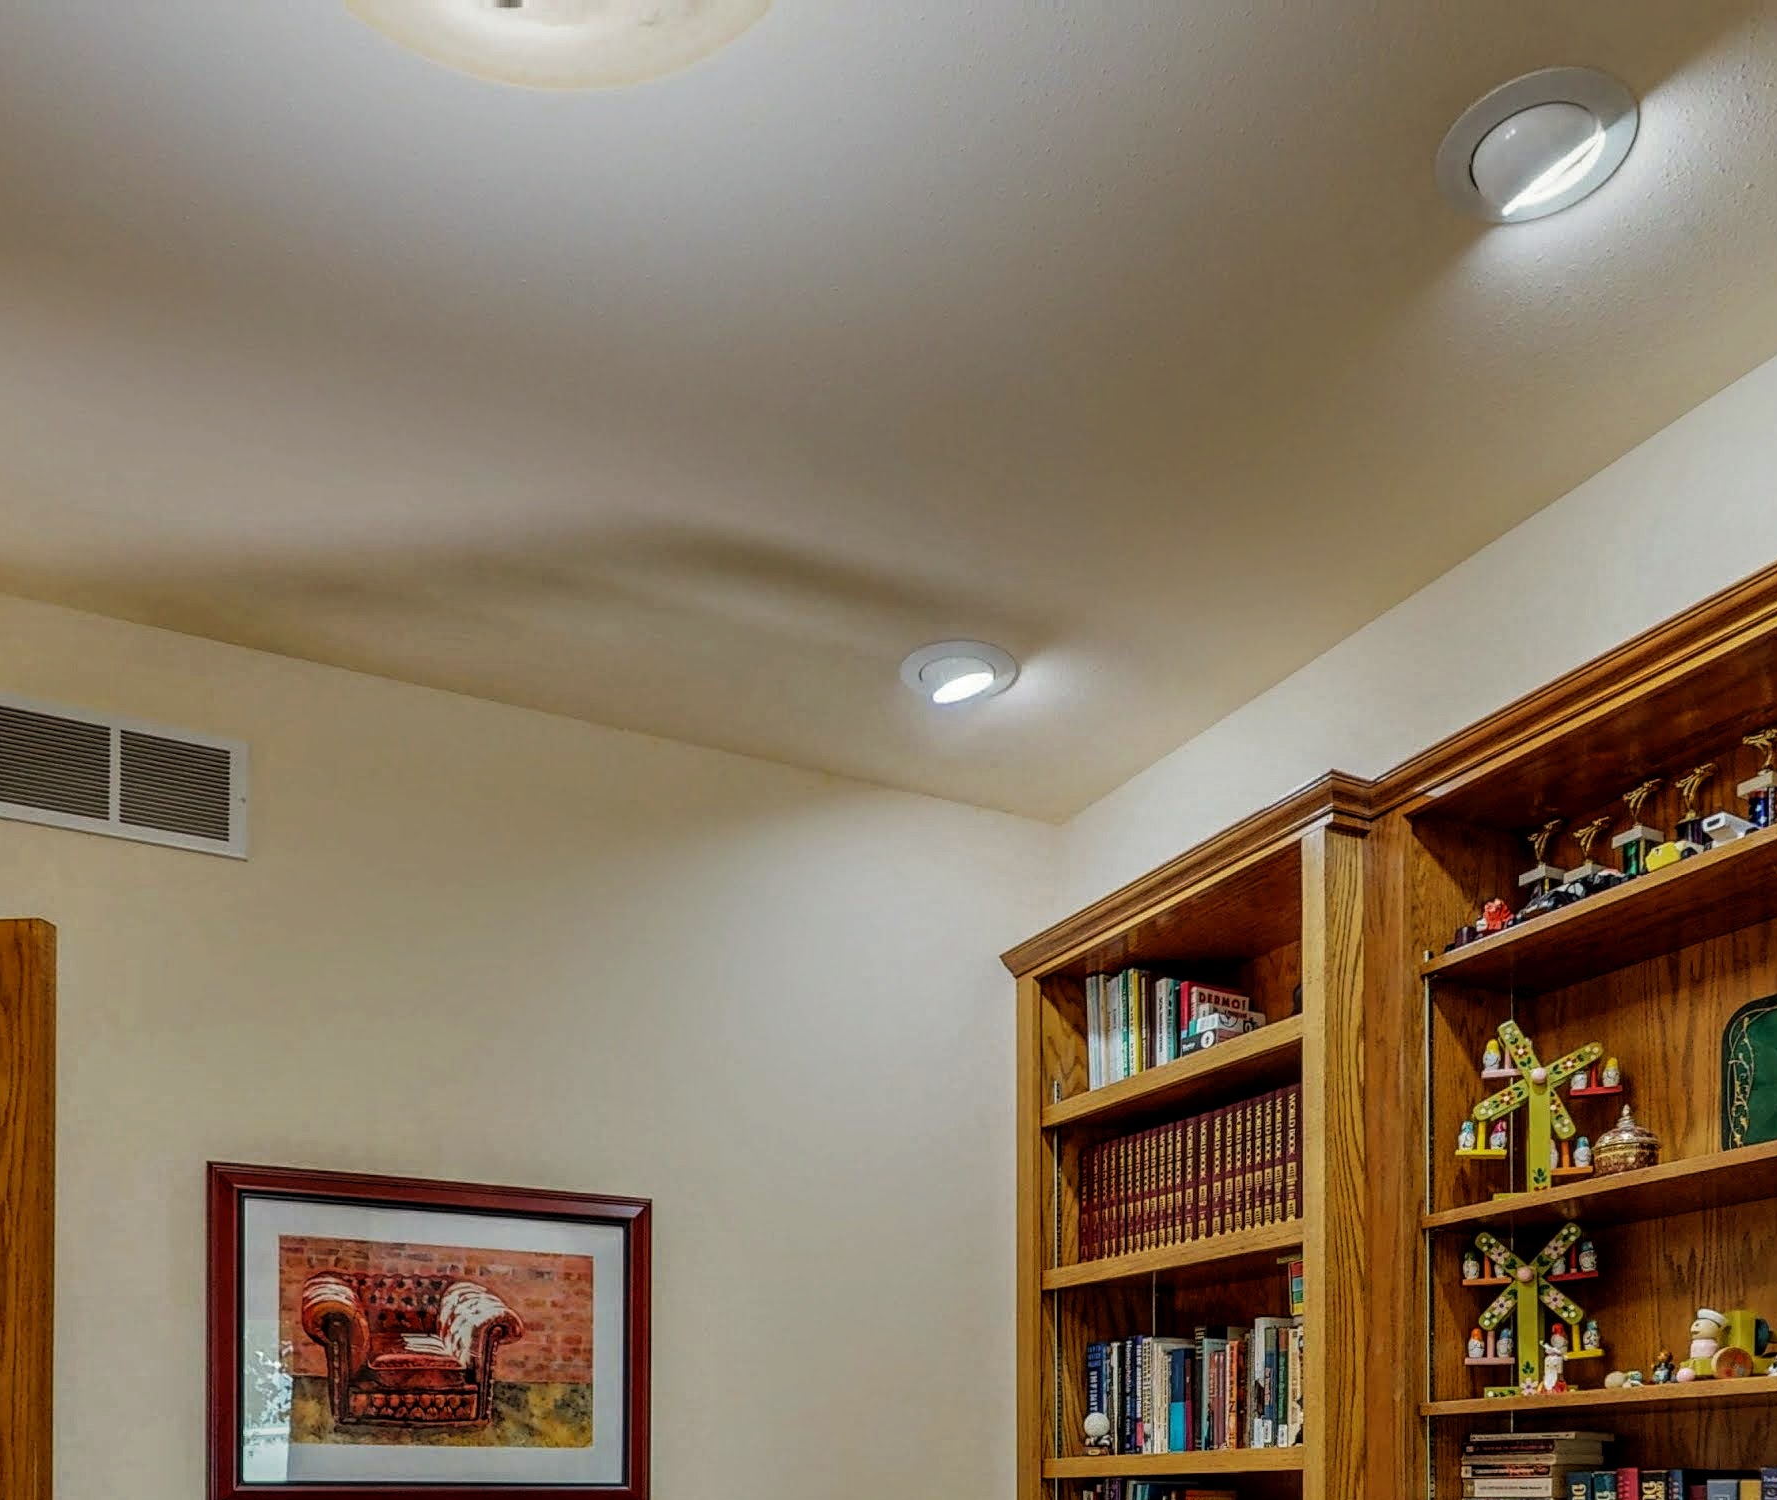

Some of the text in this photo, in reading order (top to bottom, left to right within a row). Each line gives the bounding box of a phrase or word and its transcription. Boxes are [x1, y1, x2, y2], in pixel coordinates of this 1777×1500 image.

[1198, 991, 1246, 1011] DERMO!
[1274, 1097, 1283, 1159] WORLD BOOK
[1288, 1092, 1296, 1155] WORLD BOOK
